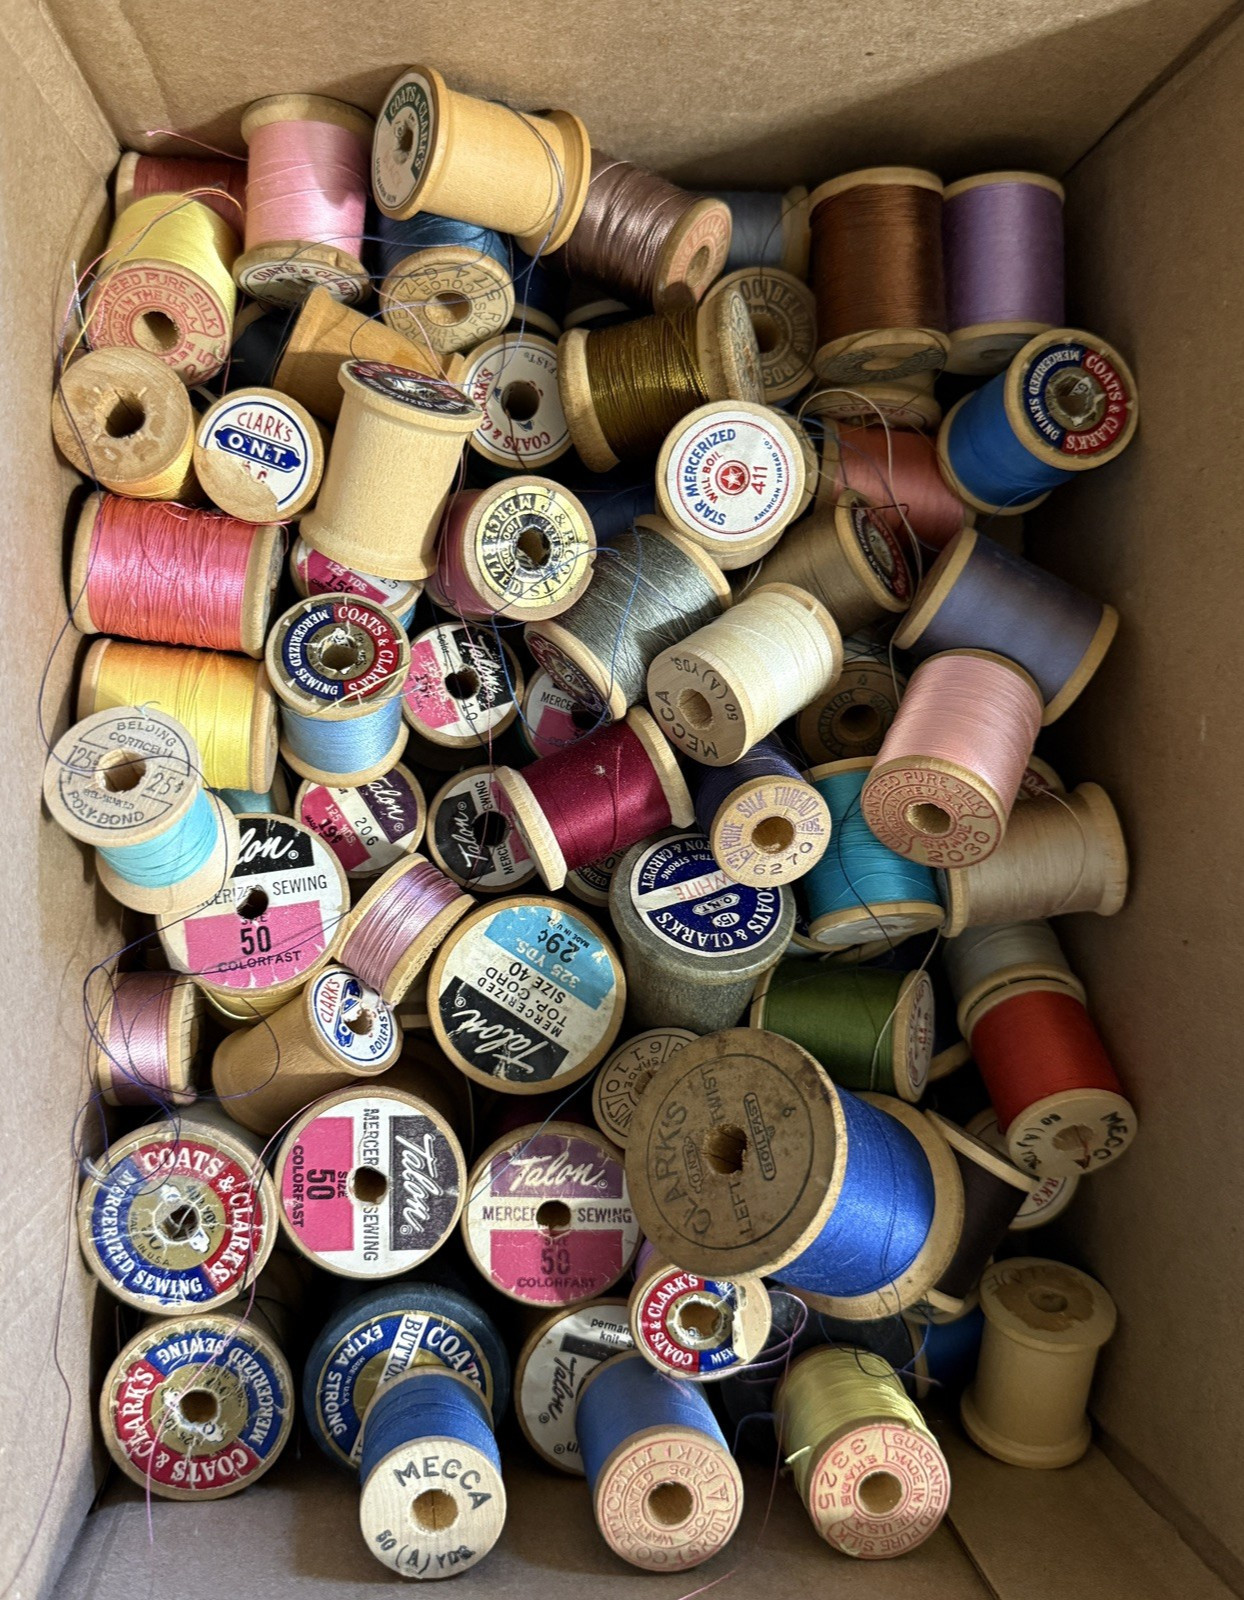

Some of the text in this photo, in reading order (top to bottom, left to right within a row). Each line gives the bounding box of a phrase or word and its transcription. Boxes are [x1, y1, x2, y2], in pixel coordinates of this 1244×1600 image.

[145, 272, 219, 330] PURE SILK
[422, 279, 474, 294] COLOR
[1029, 350, 1080, 440] MERCERIZED SEWING
[1067, 355, 1122, 451] COATS & CLARK'S
[237, 411, 293, 442] CLARK'S
[492, 429, 550, 452] COATS &
[228, 433, 287, 467] O.N.T.
[684, 428, 736, 525] STAR MERCERIZED
[701, 451, 724, 503] WILL BOIL
[751, 466, 768, 495] 411
[753, 437, 783, 522] AMERICAN THREAD CO.
[288, 609, 330, 667] MERCERIZED
[338, 606, 386, 637] COATS
[377, 638, 390, 647] &
[295, 668, 338, 695] SEWING
[655, 690, 719, 760] MECCA
[725, 703, 739, 721] 50
[109, 732, 173, 758] CORTICELLI
[117, 721, 177, 747] BELDING
[68, 791, 145, 825] POLY-BOND
[475, 780, 486, 812] EWING
[865, 771, 989, 851] GUARANTEED PURE SILK
[354, 817, 380, 847] 206
[720, 786, 819, 850] PURE SILK THREAD
[237, 828, 294, 865] lon
[452, 813, 490, 868] Talon
[753, 841, 813, 876] 6270
[927, 830, 991, 864] 2030
[272, 874, 328, 896] SEWING
[641, 843, 682, 889] & CARPET
[662, 856, 690, 880] STRONG
[240, 925, 272, 955] 50
[537, 928, 581, 963] 29¢
[563, 928, 590, 949] MADE IN
[656, 912, 733, 948] CLARK'S
[734, 929, 748, 940] &
[217, 950, 302, 973] COLORFAST
[516, 938, 581, 988] 325 YDS.
[320, 978, 341, 1023] CLARK'S
[485, 966, 530, 1000] CORD
[508, 961, 566, 1005] SIZE 40
[477, 977, 563, 1038] MERCERIZED
[369, 1008, 388, 1054] BOILFAST
[452, 1009, 549, 1074] Talon
[624, 1057, 659, 1089] SHADE
[702, 1067, 753, 1237] LEFT TWIST
[746, 1098, 774, 1176] BOILFAST
[1073, 1111, 1128, 1169] MECCA
[292, 1145, 304, 1228] COLORFAST
[306, 1168, 336, 1201] 50
[337, 1171, 347, 1198] SIZE
[363, 1108, 380, 1261] MERCER SEWING
[395, 1133, 443, 1232] Talon
[509, 1151, 605, 1192] Talon
[102, 1169, 203, 1296] MERCERIZED SEWING
[143, 1148, 252, 1283] COATS & CLARK'S
[482, 1206, 633, 1223] MERCER SEWING
[541, 1248, 571, 1276] 50
[517, 1277, 596, 1289] COLORFAST
[590, 1318, 632, 1335] perman
[647, 1273, 699, 1365] COATS & CLARK'S
[156, 1338, 225, 1364] SEWING
[352, 1355, 366, 1373] MADE
[228, 1347, 273, 1446] MERCERIZED
[325, 1324, 384, 1435] EXTRA STRONG
[548, 1356, 577, 1421] Talon
[123, 1367, 155, 1458] CLARK'S
[156, 1451, 170, 1468] &
[171, 1448, 249, 1482] COATS
[819, 1438, 867, 1509] 3325
[393, 1455, 493, 1510] MECCA
[706, 1482, 729, 1502] A
[835, 1433, 943, 1552] GUARANTEED PURE SILK
[892, 1451, 925, 1530] MADE IN THE
[606, 1447, 668, 1564] CORTICELLI
